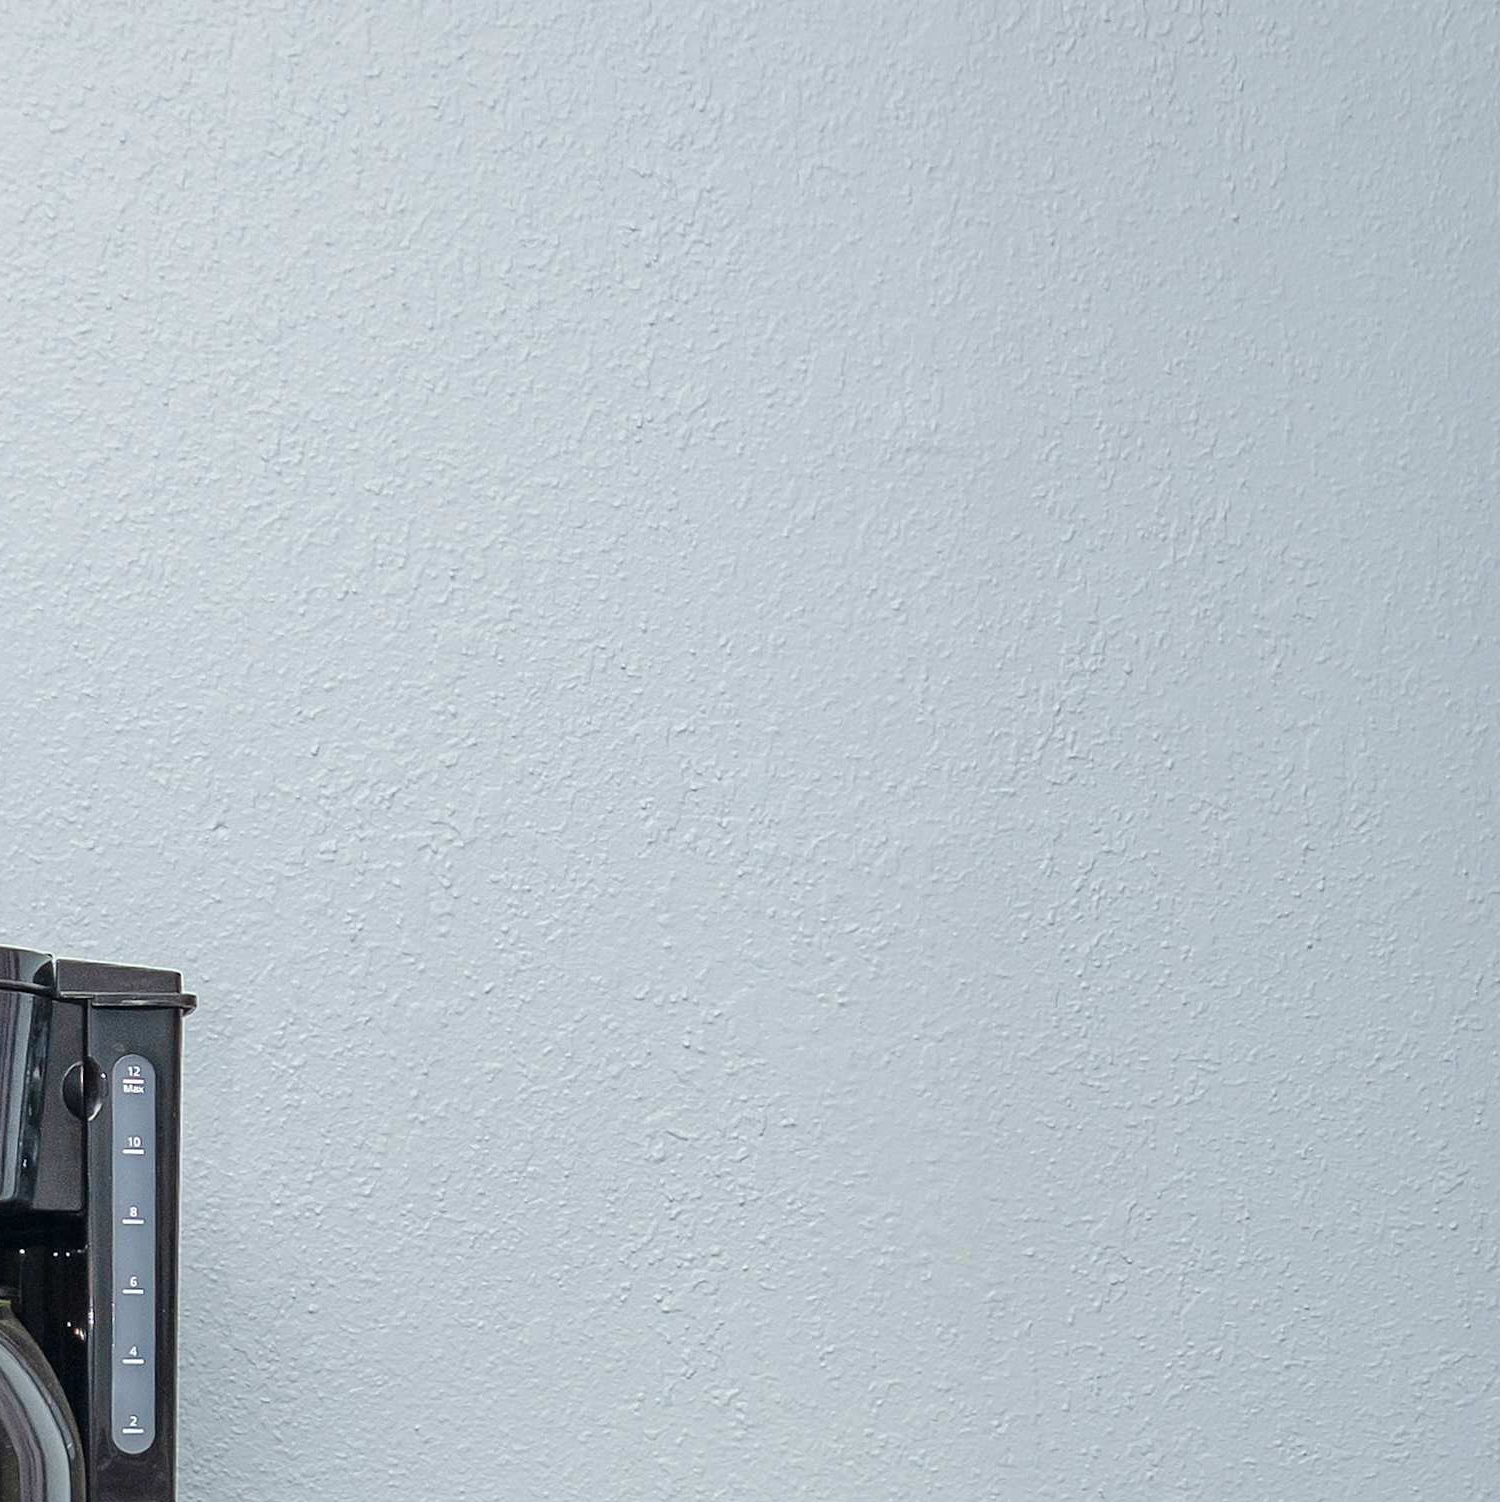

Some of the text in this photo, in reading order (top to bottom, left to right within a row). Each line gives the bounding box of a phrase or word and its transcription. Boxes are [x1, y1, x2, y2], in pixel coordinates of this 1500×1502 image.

[128, 1065, 141, 1077] 12
[123, 1084, 145, 1094] Max
[128, 1136, 142, 1148] 10
[129, 1206, 138, 1218] 8
[129, 1276, 138, 1288] 6
[129, 1346, 138, 1357] 4
[129, 1415, 138, 1427] 2
